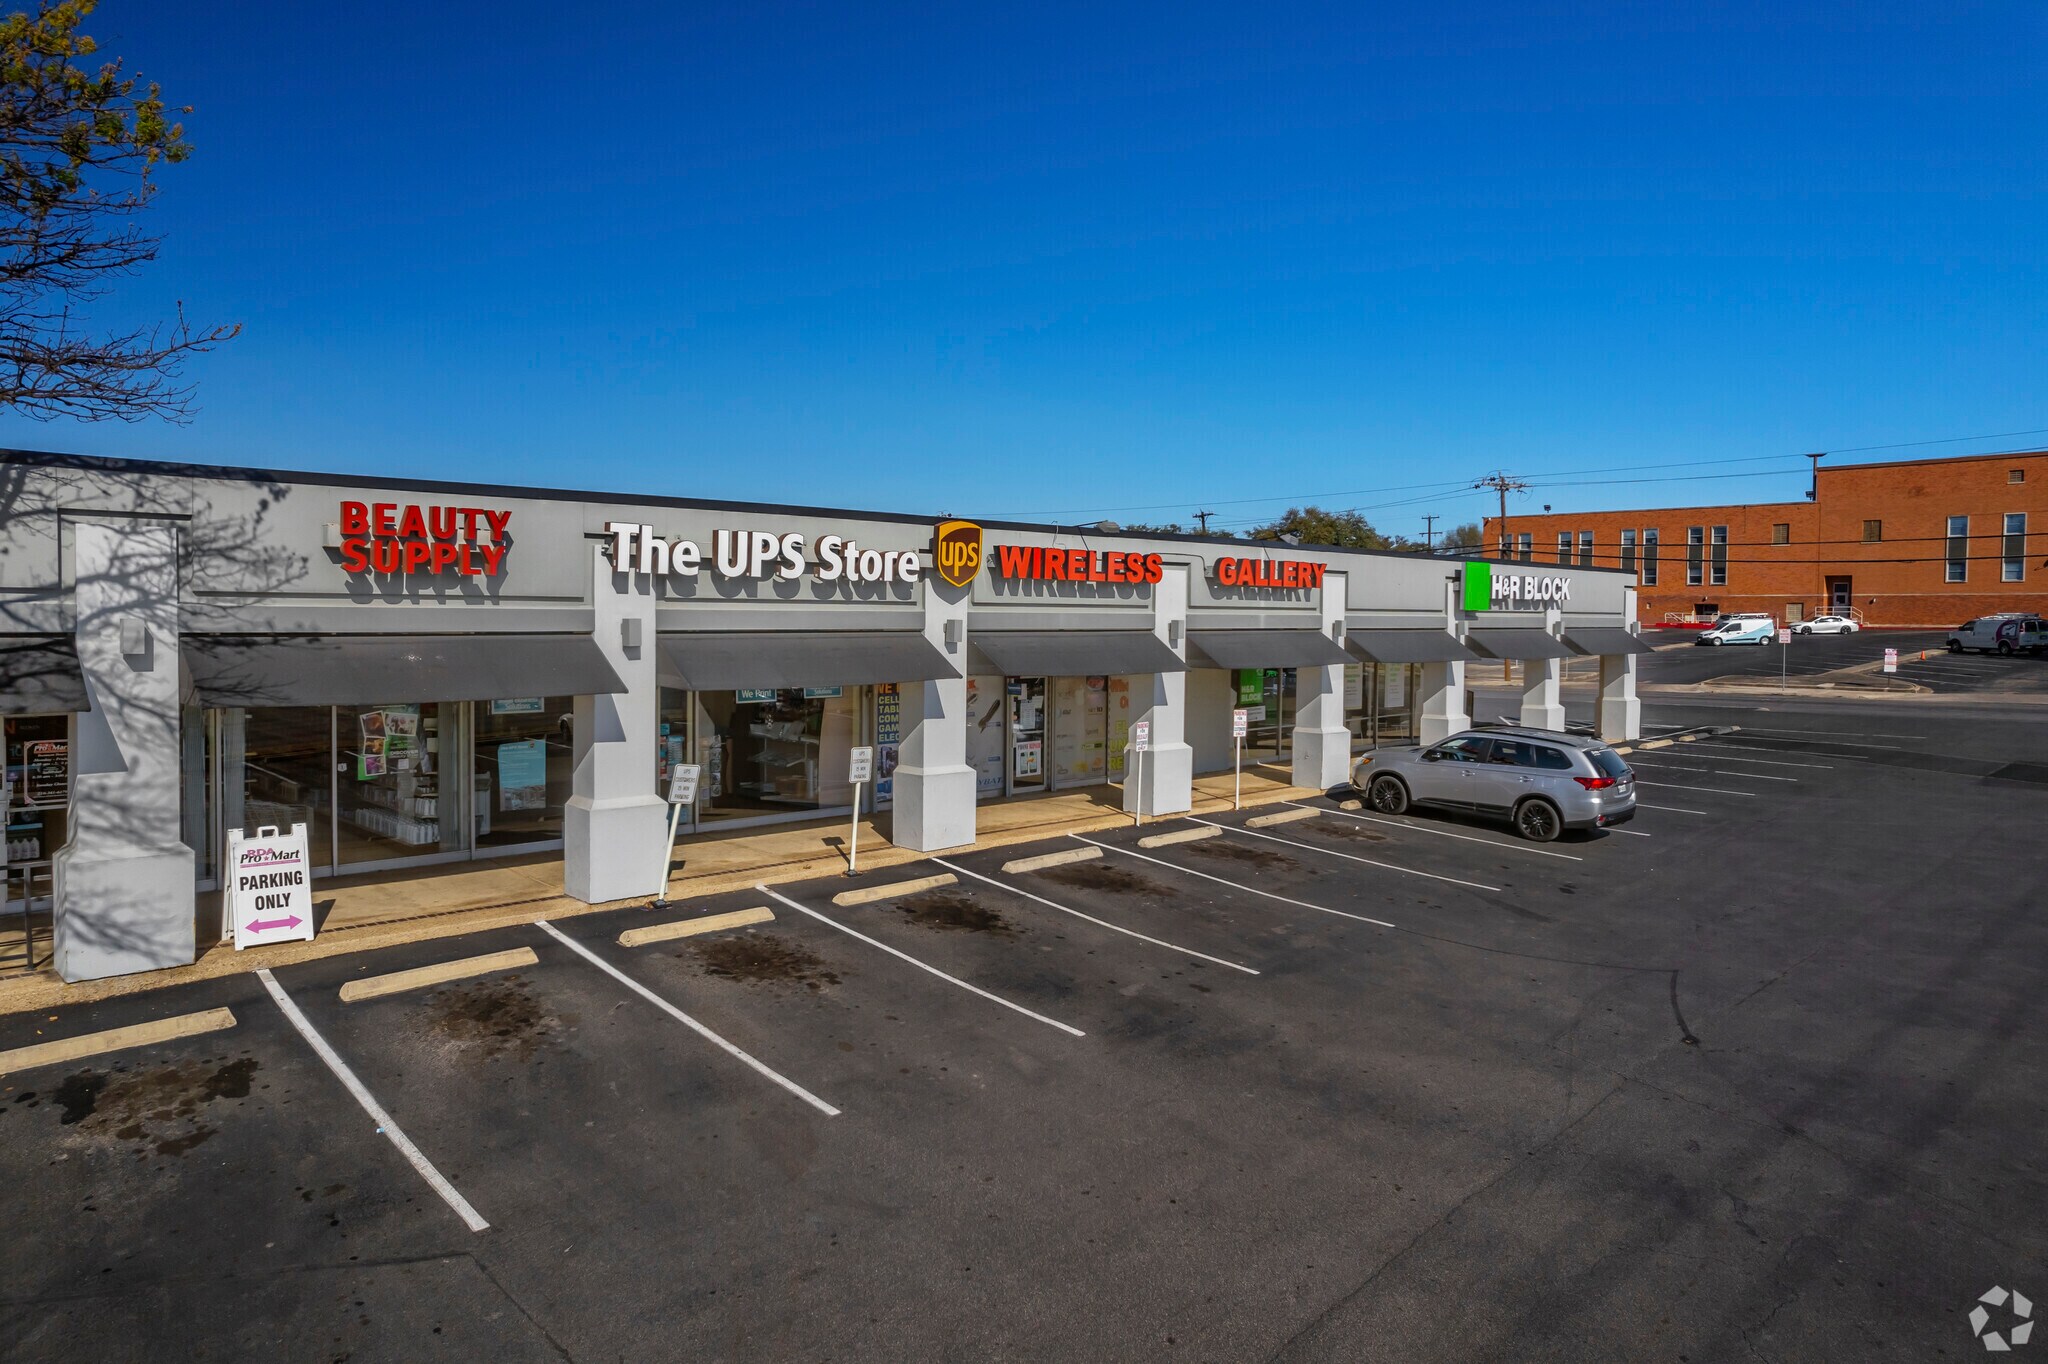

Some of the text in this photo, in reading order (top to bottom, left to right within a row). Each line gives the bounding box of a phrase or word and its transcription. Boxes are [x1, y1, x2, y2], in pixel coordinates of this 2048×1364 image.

[340, 501, 512, 541] BEAUTY
[340, 538, 505, 576] SUPPLY
[605, 522, 920, 581] The UPS Store
[941, 541, 979, 577] ups
[995, 545, 1163, 584] WIRELESS
[1215, 556, 1327, 588] GALLERY
[1491, 575, 1571, 600] H&R BLOCK
[742, 689, 753, 698] We
[240, 849, 300, 864] Pro Mart
[240, 870, 303, 891] PARKING
[255, 892, 291, 910] ONLY
